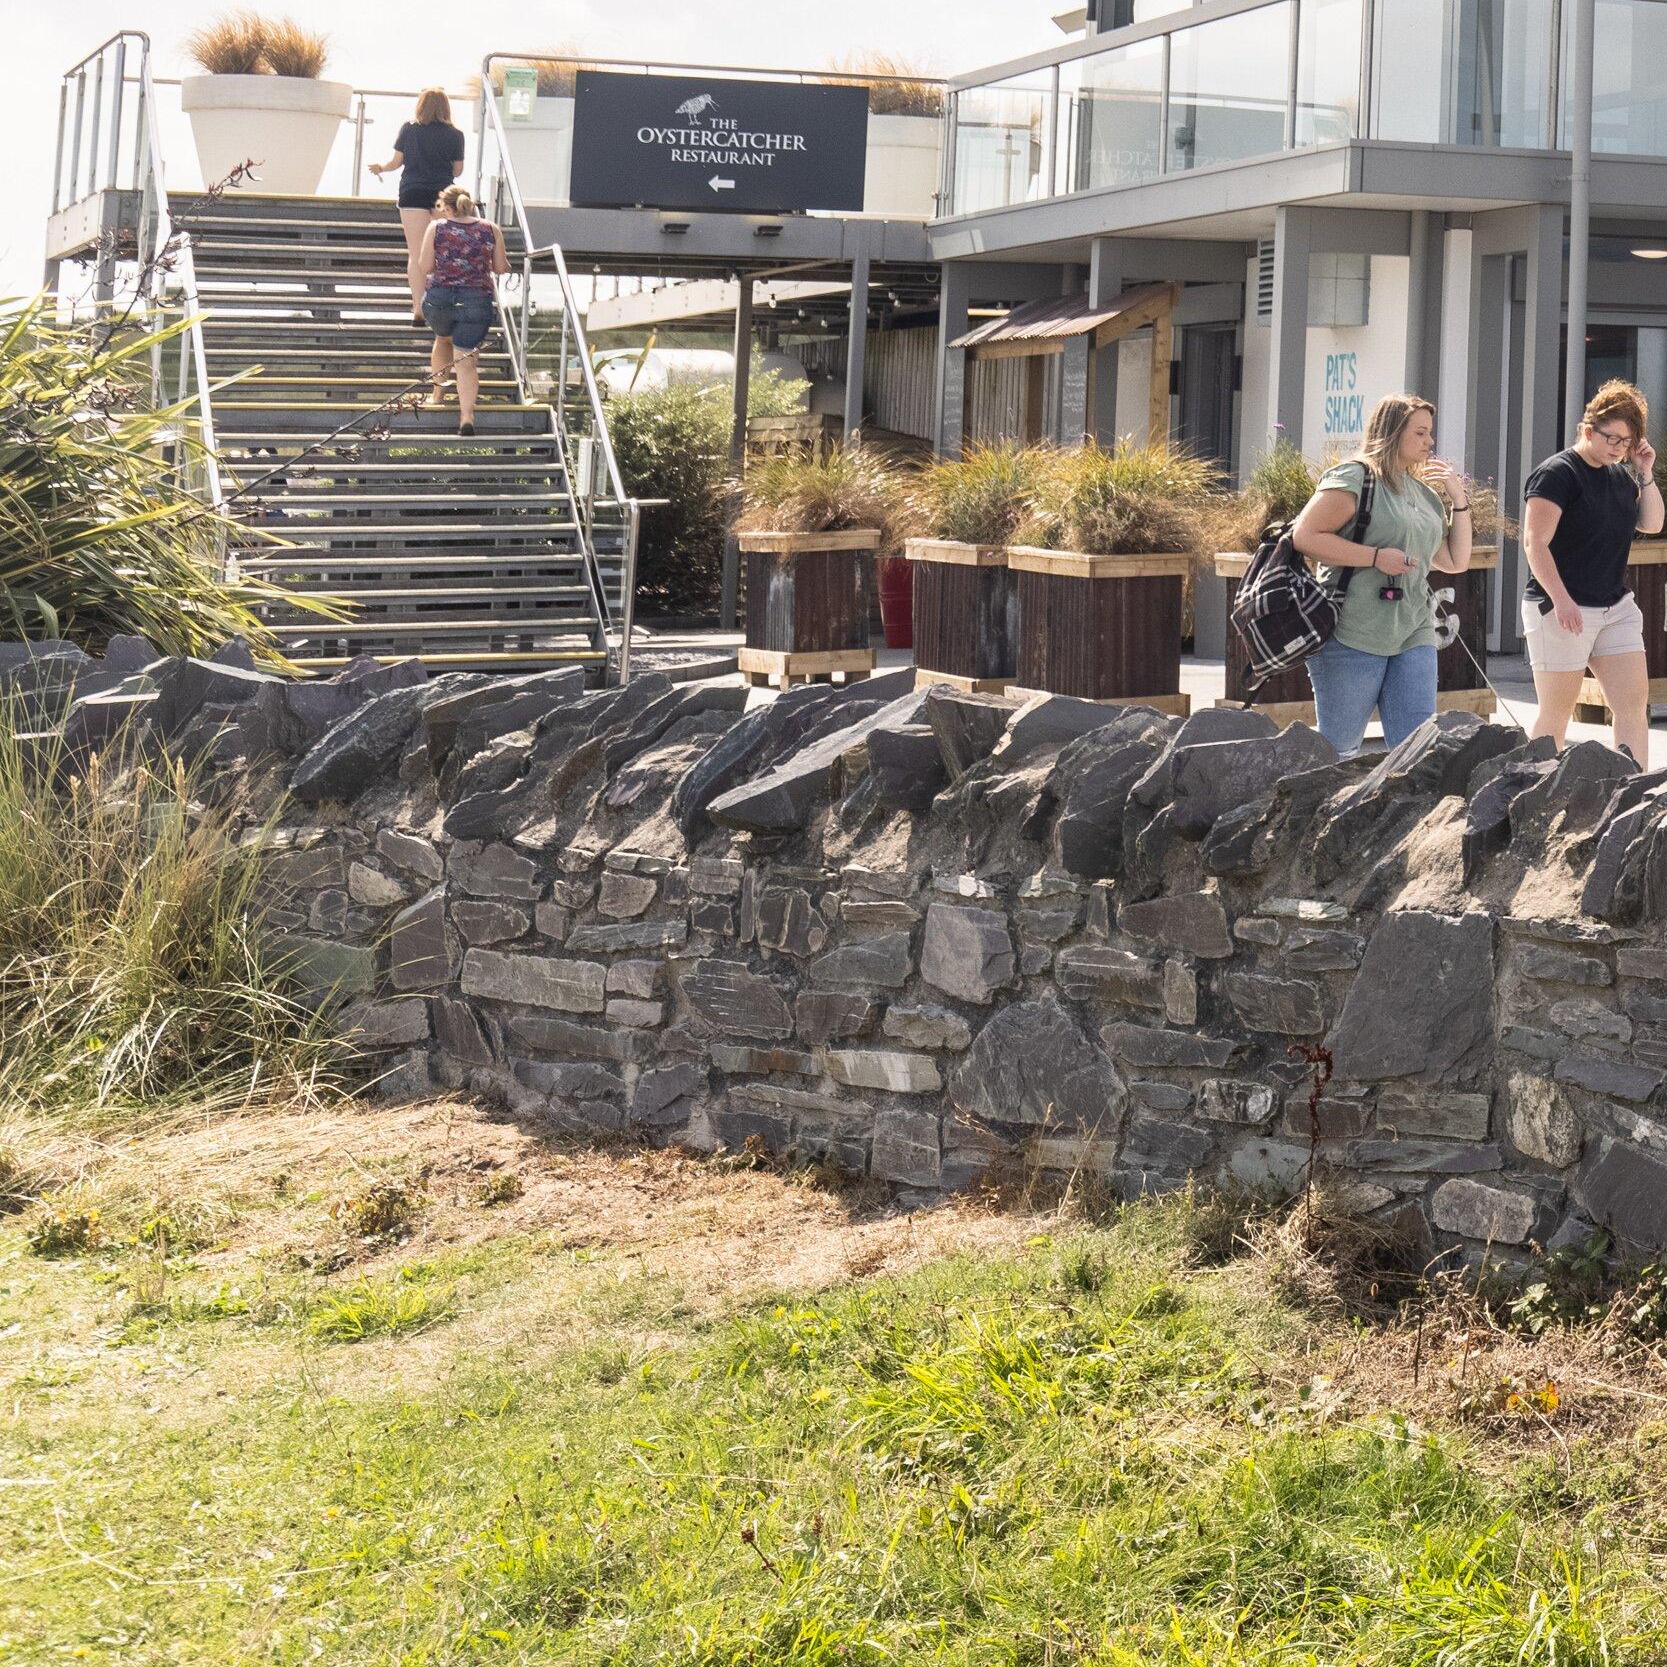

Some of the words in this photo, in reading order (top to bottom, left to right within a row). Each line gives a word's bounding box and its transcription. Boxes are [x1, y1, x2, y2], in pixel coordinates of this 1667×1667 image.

[709, 117, 738, 131] THE
[637, 127, 807, 151] OYSTERCATCHER
[670, 148, 776, 166] RESTAURANT
[1325, 352, 1357, 392] PAT'S
[1324, 394, 1365, 434] SHACK
